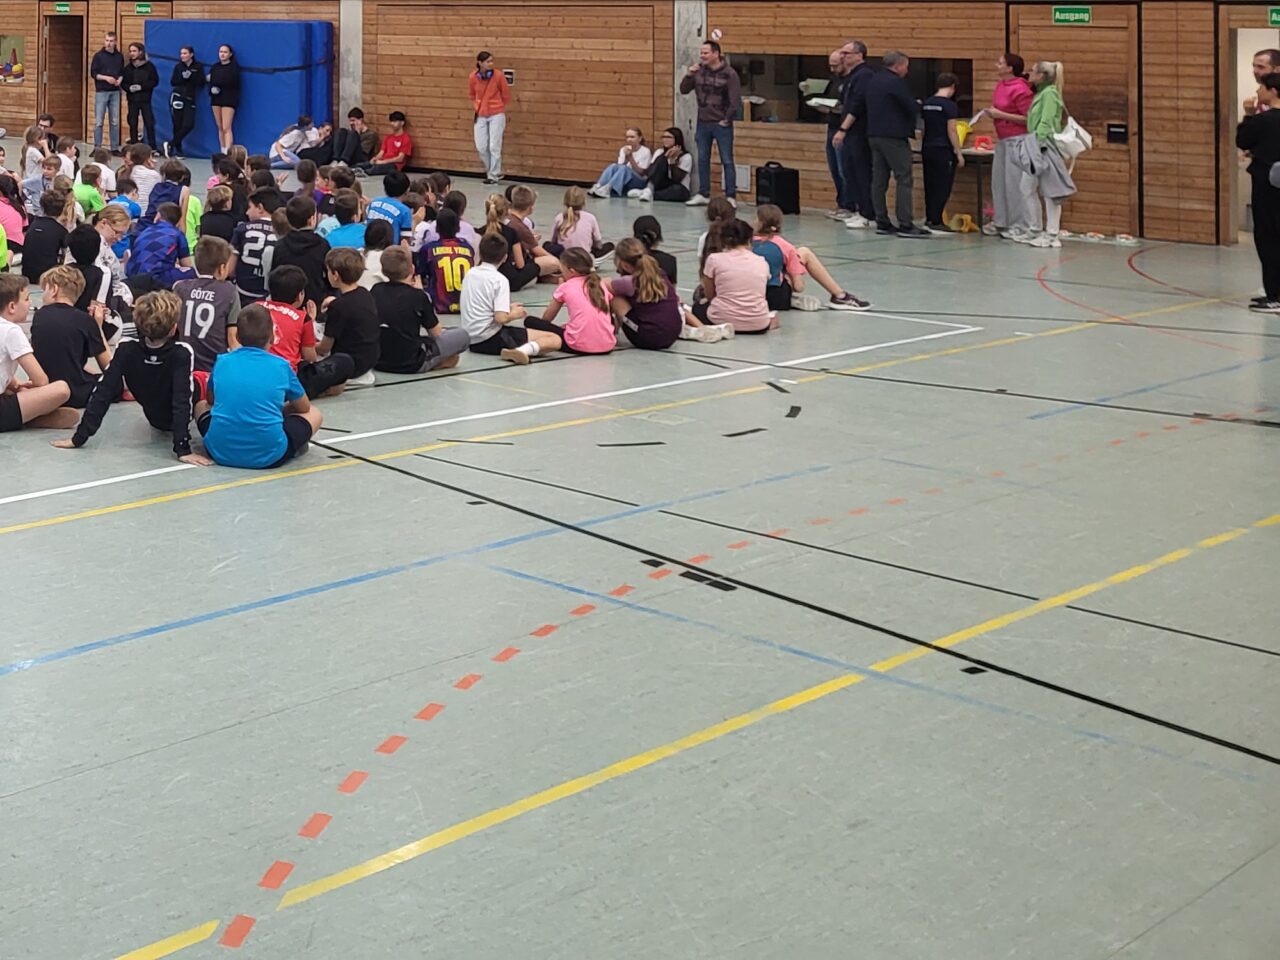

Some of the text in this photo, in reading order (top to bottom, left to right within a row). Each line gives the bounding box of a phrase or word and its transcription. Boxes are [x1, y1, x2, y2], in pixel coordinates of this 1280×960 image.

[1054, 11, 1090, 22] Ausgang
[437, 256, 471, 292] 10
[190, 287, 216, 302] GÖTZE
[183, 300, 216, 339] 19
